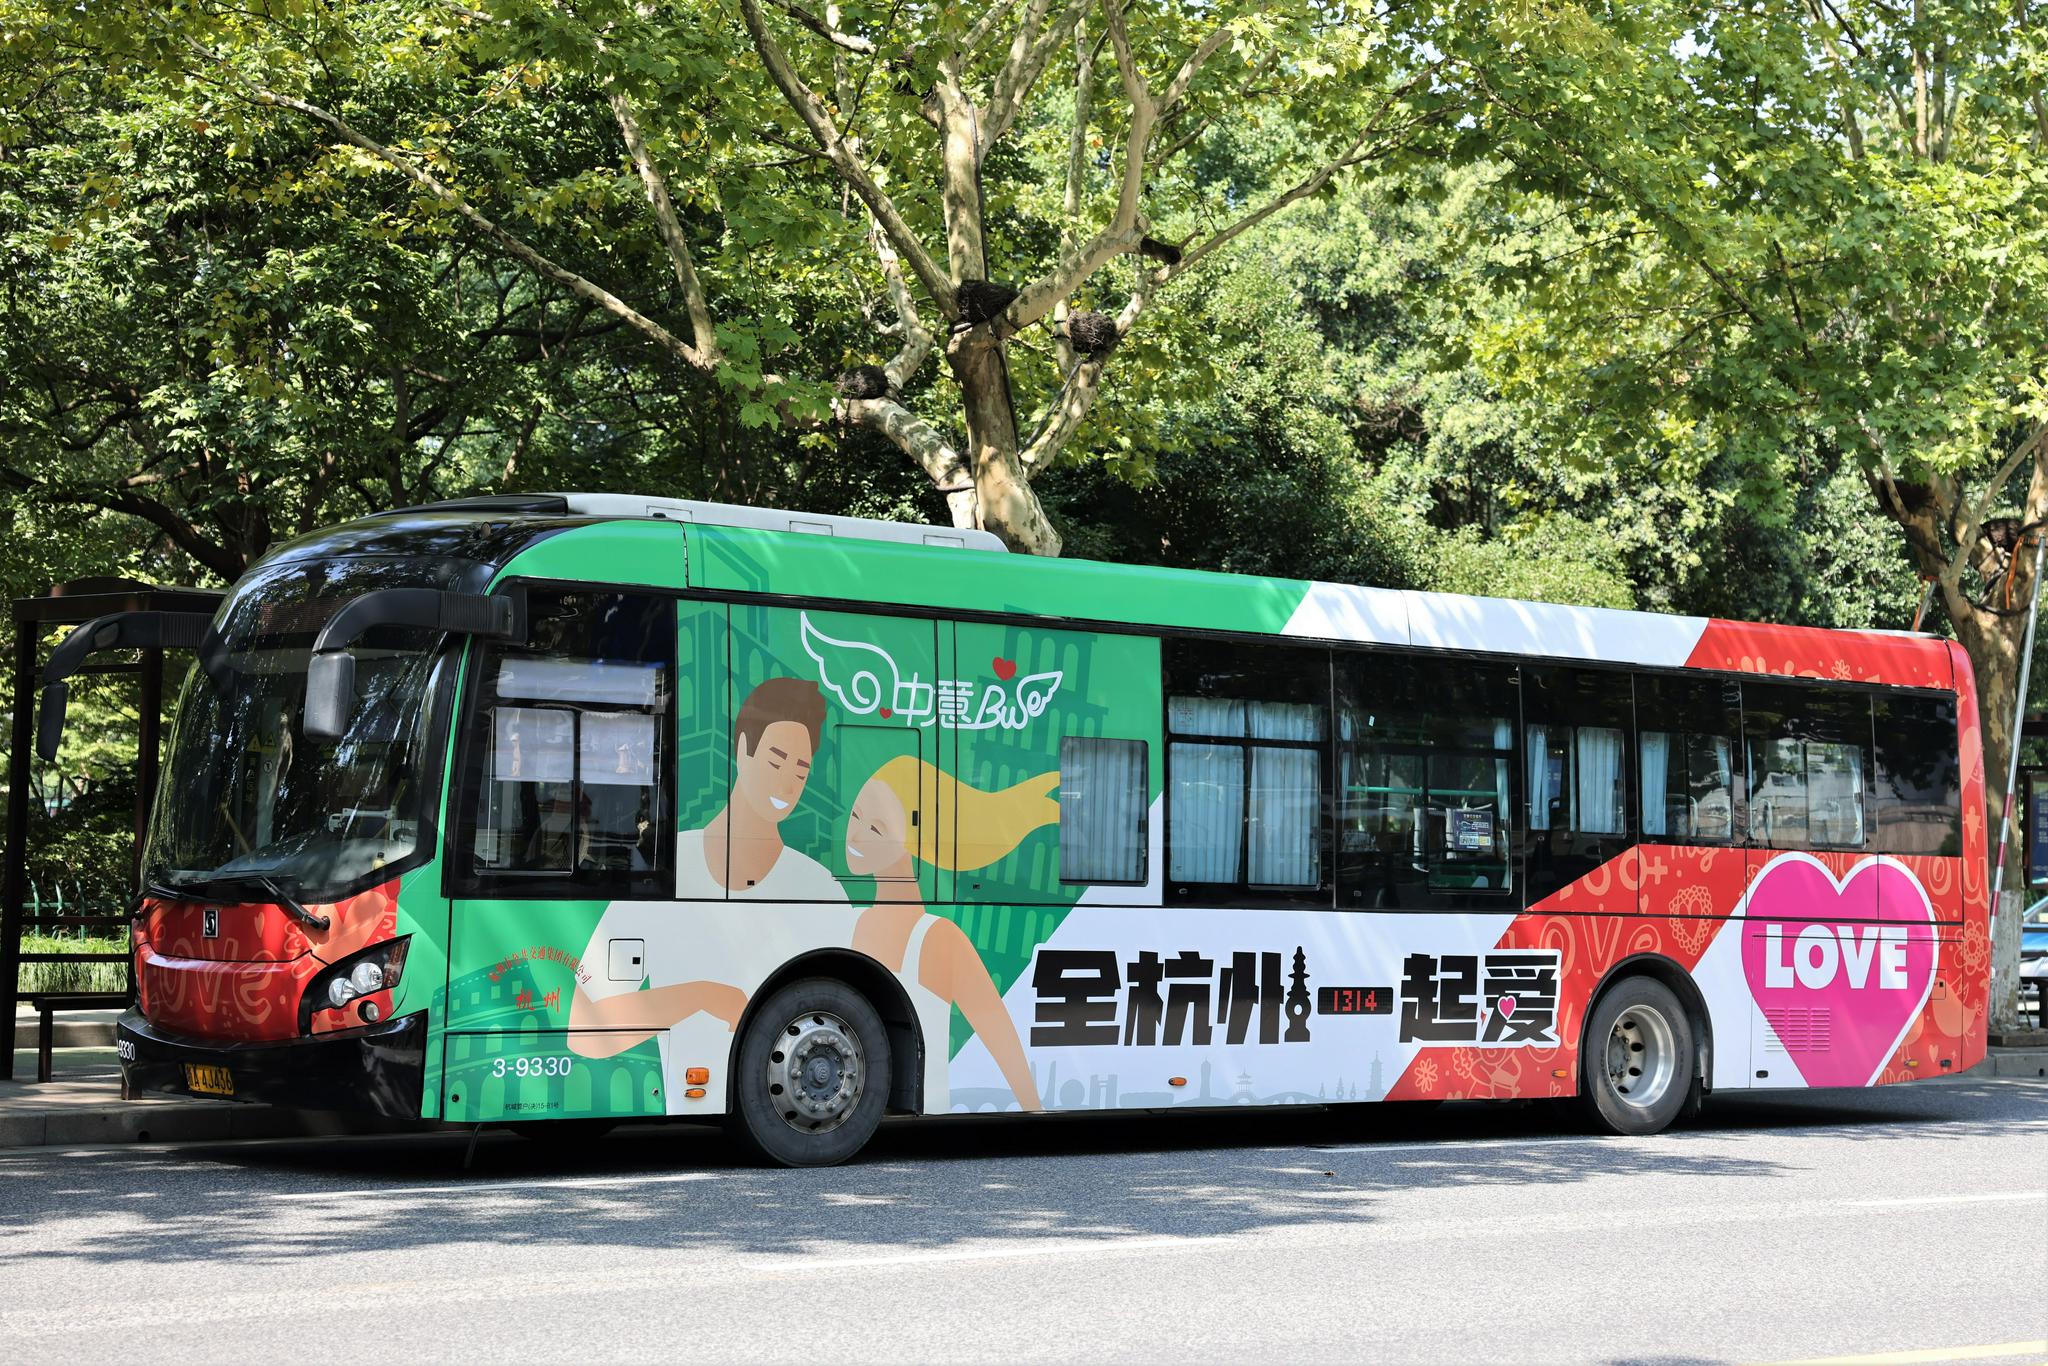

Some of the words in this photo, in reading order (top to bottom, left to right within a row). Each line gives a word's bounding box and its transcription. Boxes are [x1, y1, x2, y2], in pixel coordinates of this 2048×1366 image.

[1764, 923, 1909, 990] LOVE
[1030, 945, 1312, 1048] 全杭州
[1333, 989, 1378, 1012] 1314
[492, 1056, 572, 1078] 3-9330
